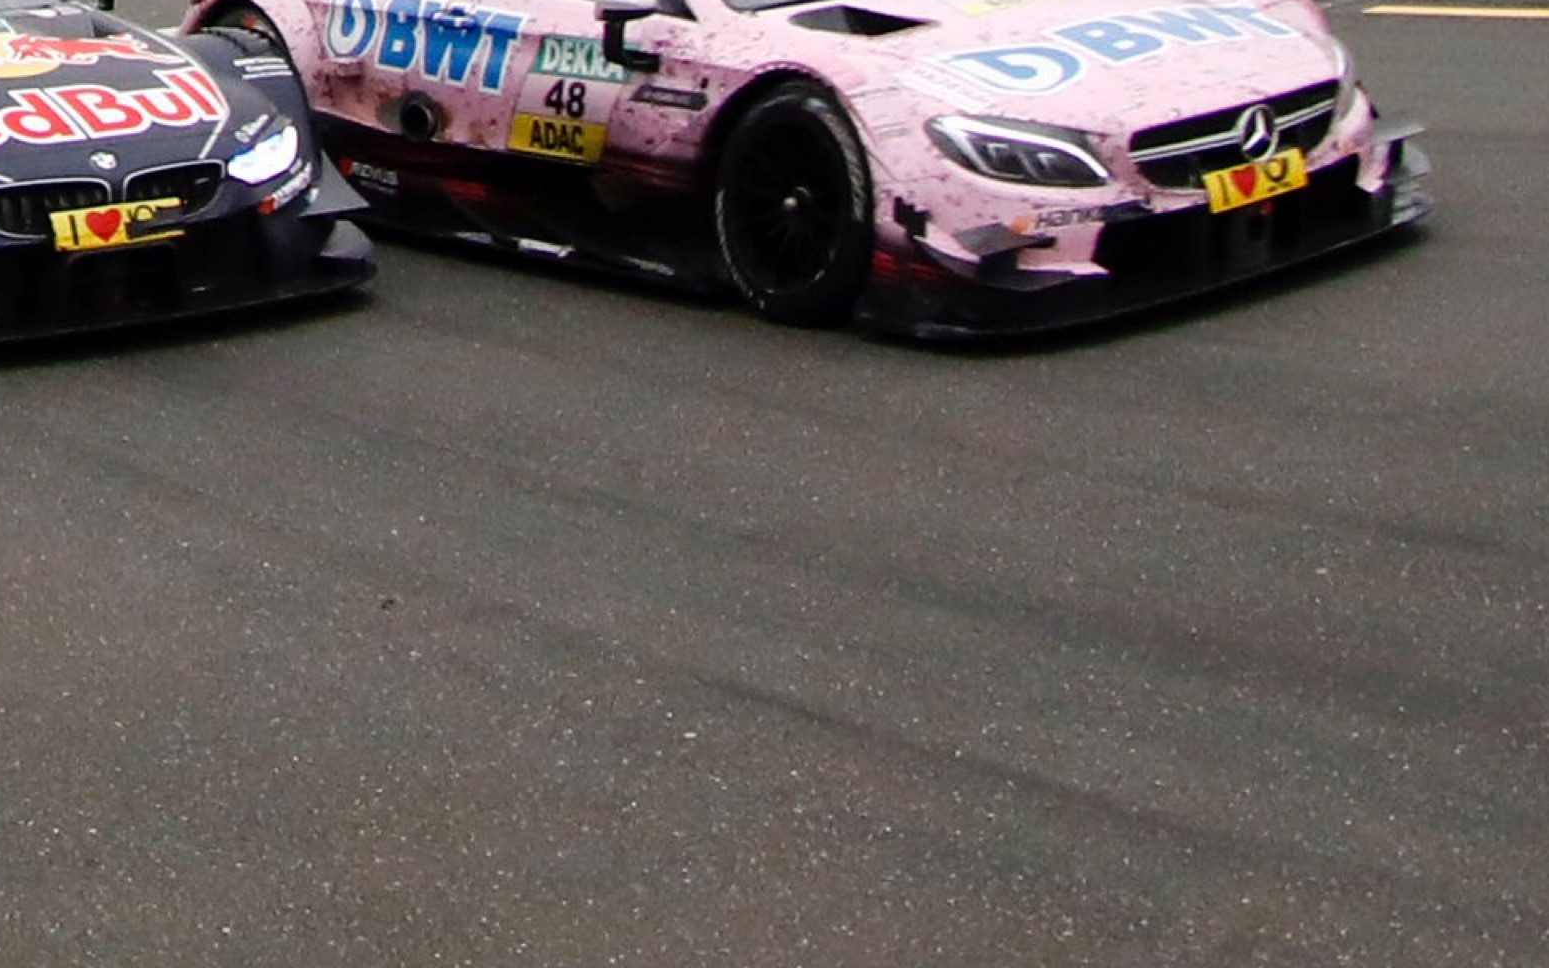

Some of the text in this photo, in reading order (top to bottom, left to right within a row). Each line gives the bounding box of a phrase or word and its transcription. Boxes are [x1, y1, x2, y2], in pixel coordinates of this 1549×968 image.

[1053, 7, 1293, 61] BWT
[57, 69, 227, 135] Bull
[545, 79, 586, 118] 48
[531, 119, 584, 155] ADAC
